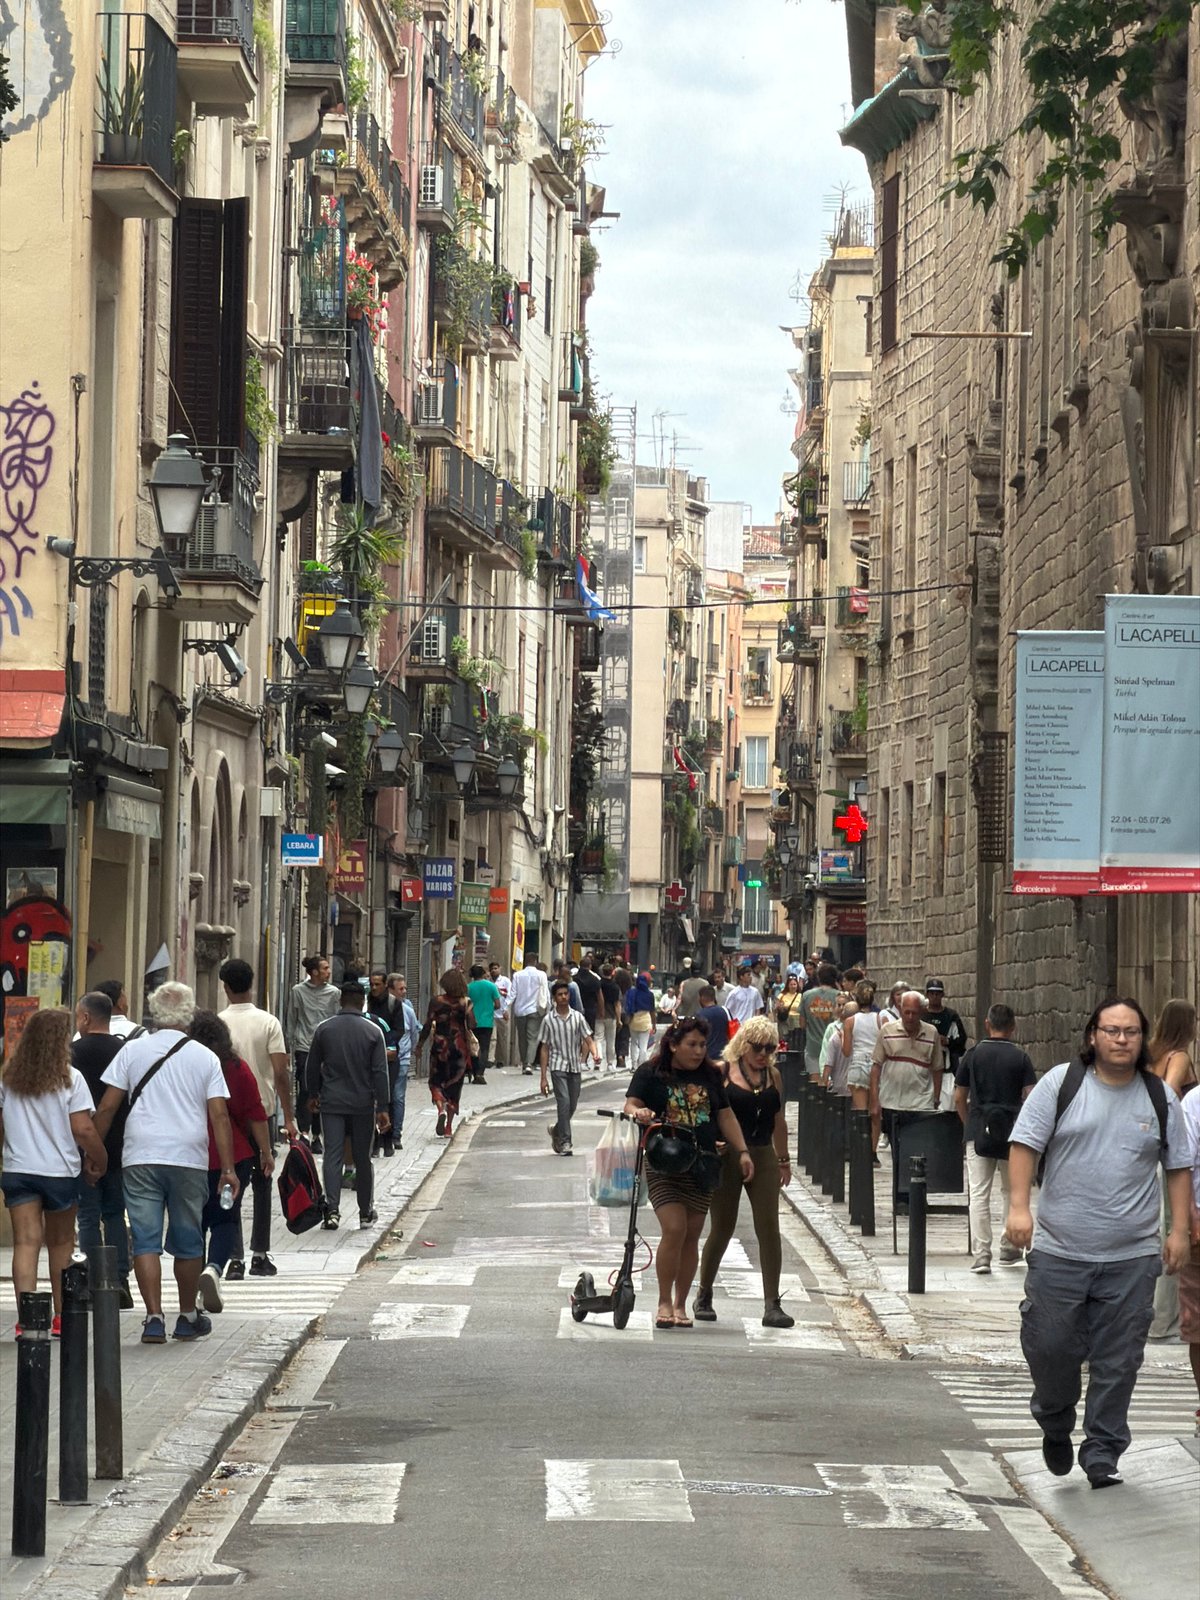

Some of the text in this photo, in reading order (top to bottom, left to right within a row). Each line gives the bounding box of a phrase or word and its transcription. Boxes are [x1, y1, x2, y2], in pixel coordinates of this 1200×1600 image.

[1114, 676, 1175, 687] Sinéad Spelman
[1113, 711, 1136, 721] Mikel
[1161, 713, 1186, 722] Tolosa
[286, 842, 315, 850] LEBARA
[426, 864, 453, 877] BAZAR
[426, 882, 453, 892] VARIOS
[1015, 885, 1050, 893] Barcelona
[1101, 883, 1140, 891] Barcelona
